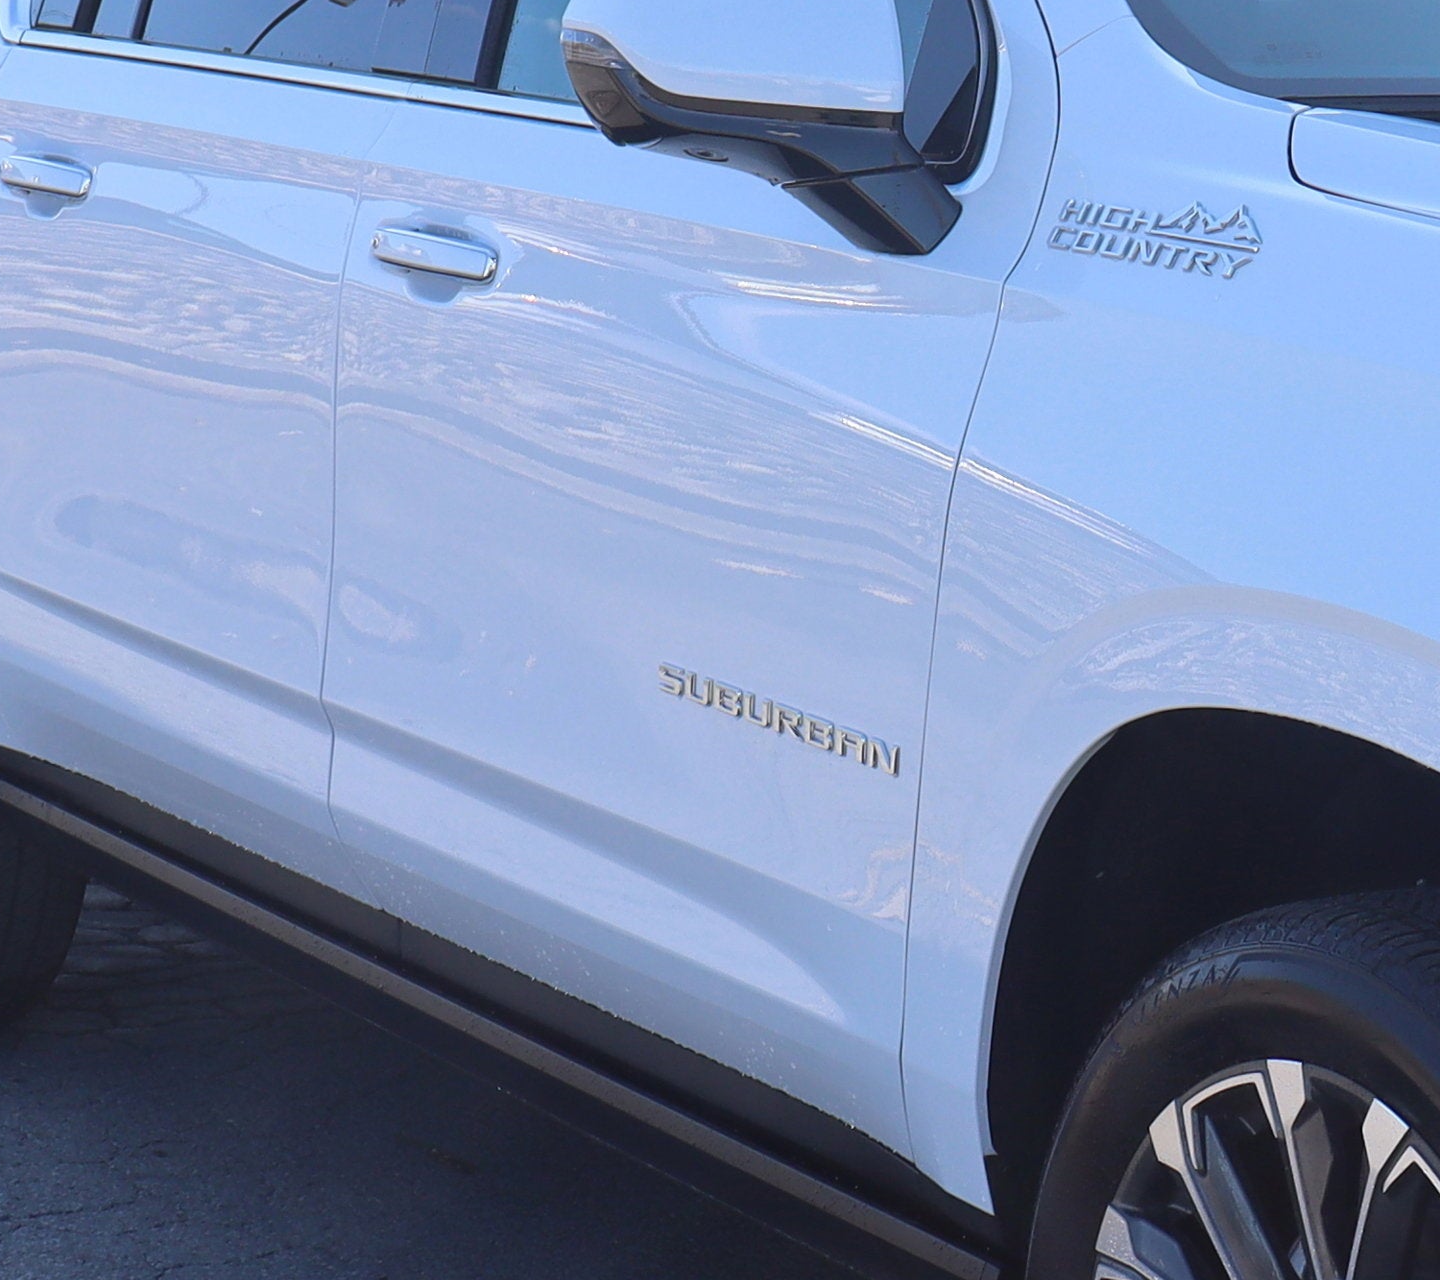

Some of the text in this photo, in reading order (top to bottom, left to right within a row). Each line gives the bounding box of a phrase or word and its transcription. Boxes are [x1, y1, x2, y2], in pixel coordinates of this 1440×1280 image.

[1060, 198, 1164, 233] HIGH
[1047, 225, 1253, 279] COUNTRY
[658, 661, 902, 777] SUBURBAN
